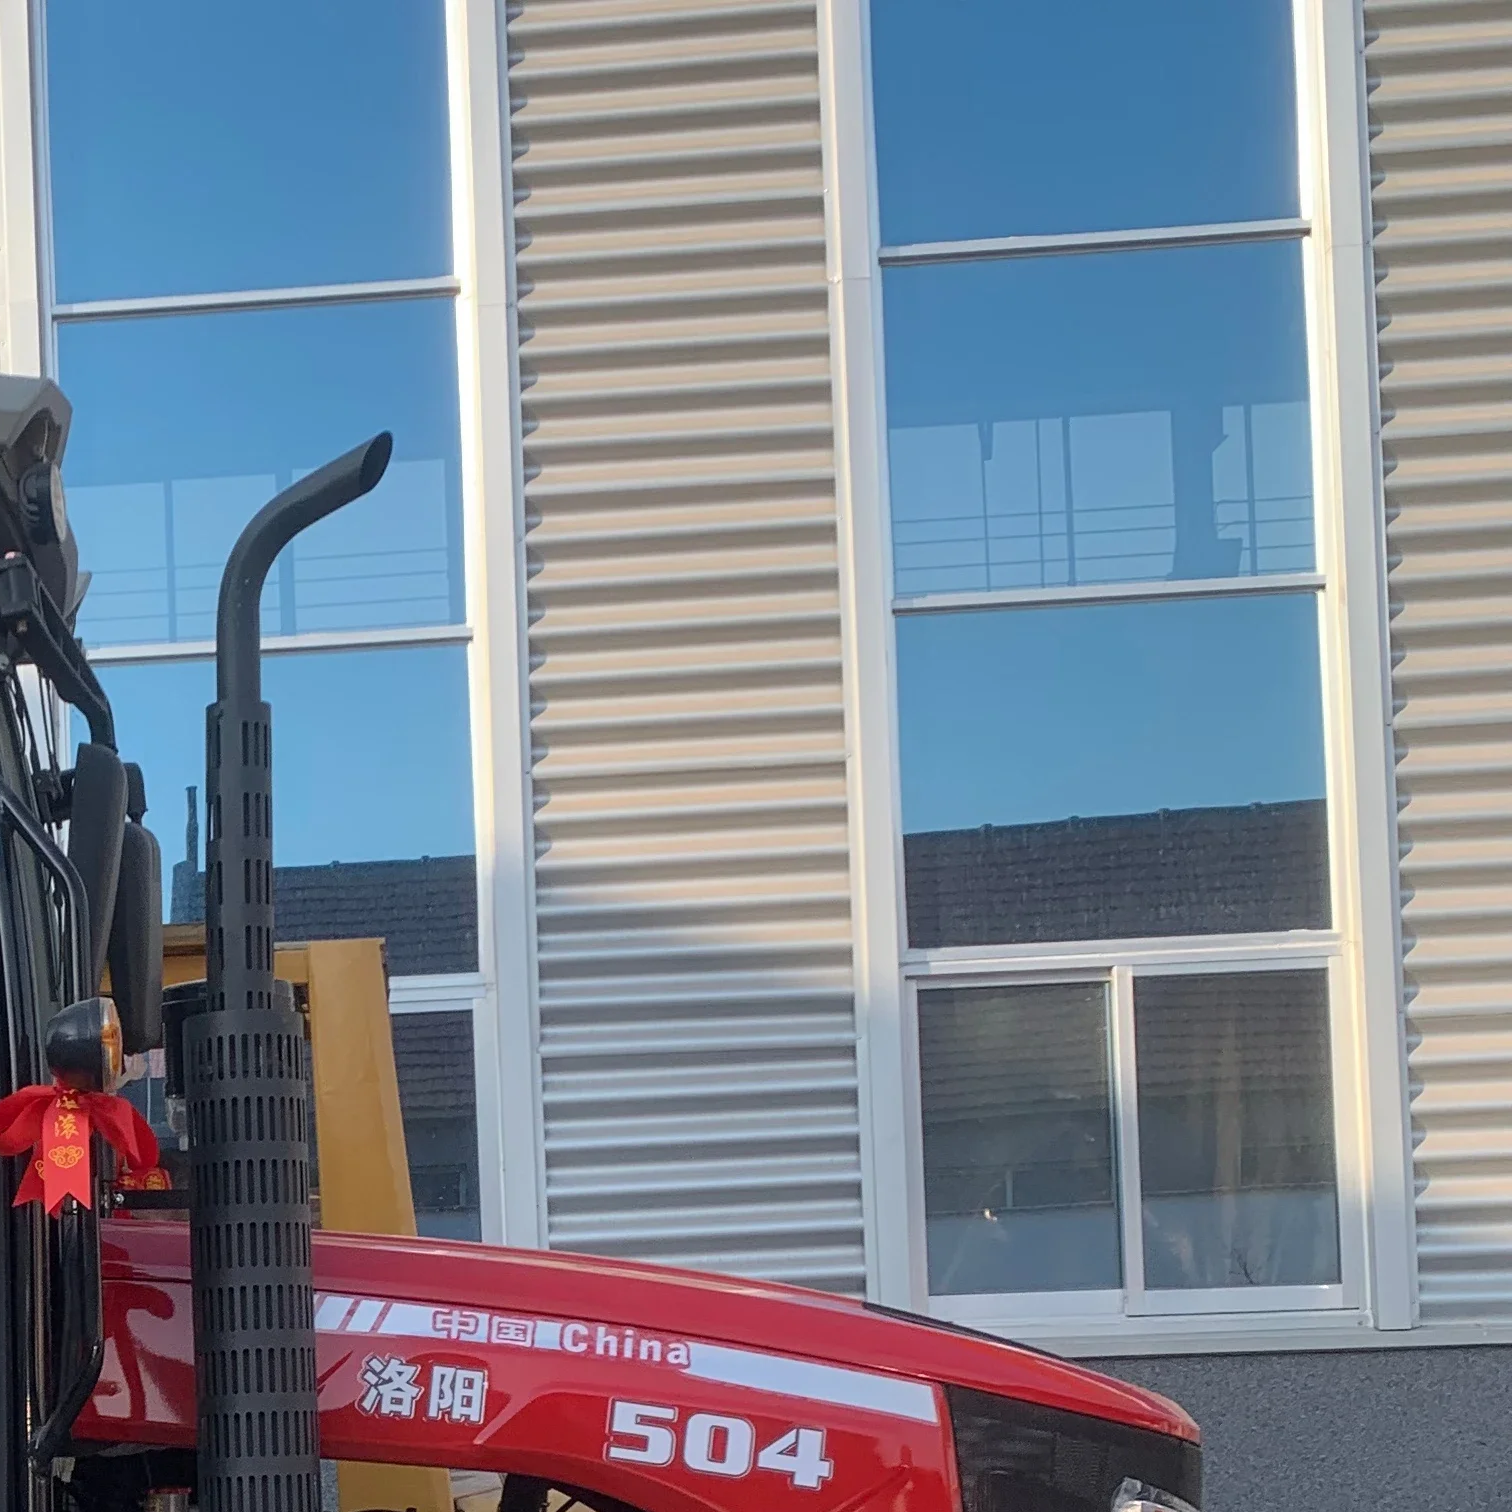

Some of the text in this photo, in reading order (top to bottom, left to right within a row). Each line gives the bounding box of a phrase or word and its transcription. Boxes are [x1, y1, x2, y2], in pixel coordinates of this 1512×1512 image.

[433, 1309, 690, 1366] 中国 China
[358, 1354, 486, 1424] 洛阳
[605, 1398, 833, 1490] 504
